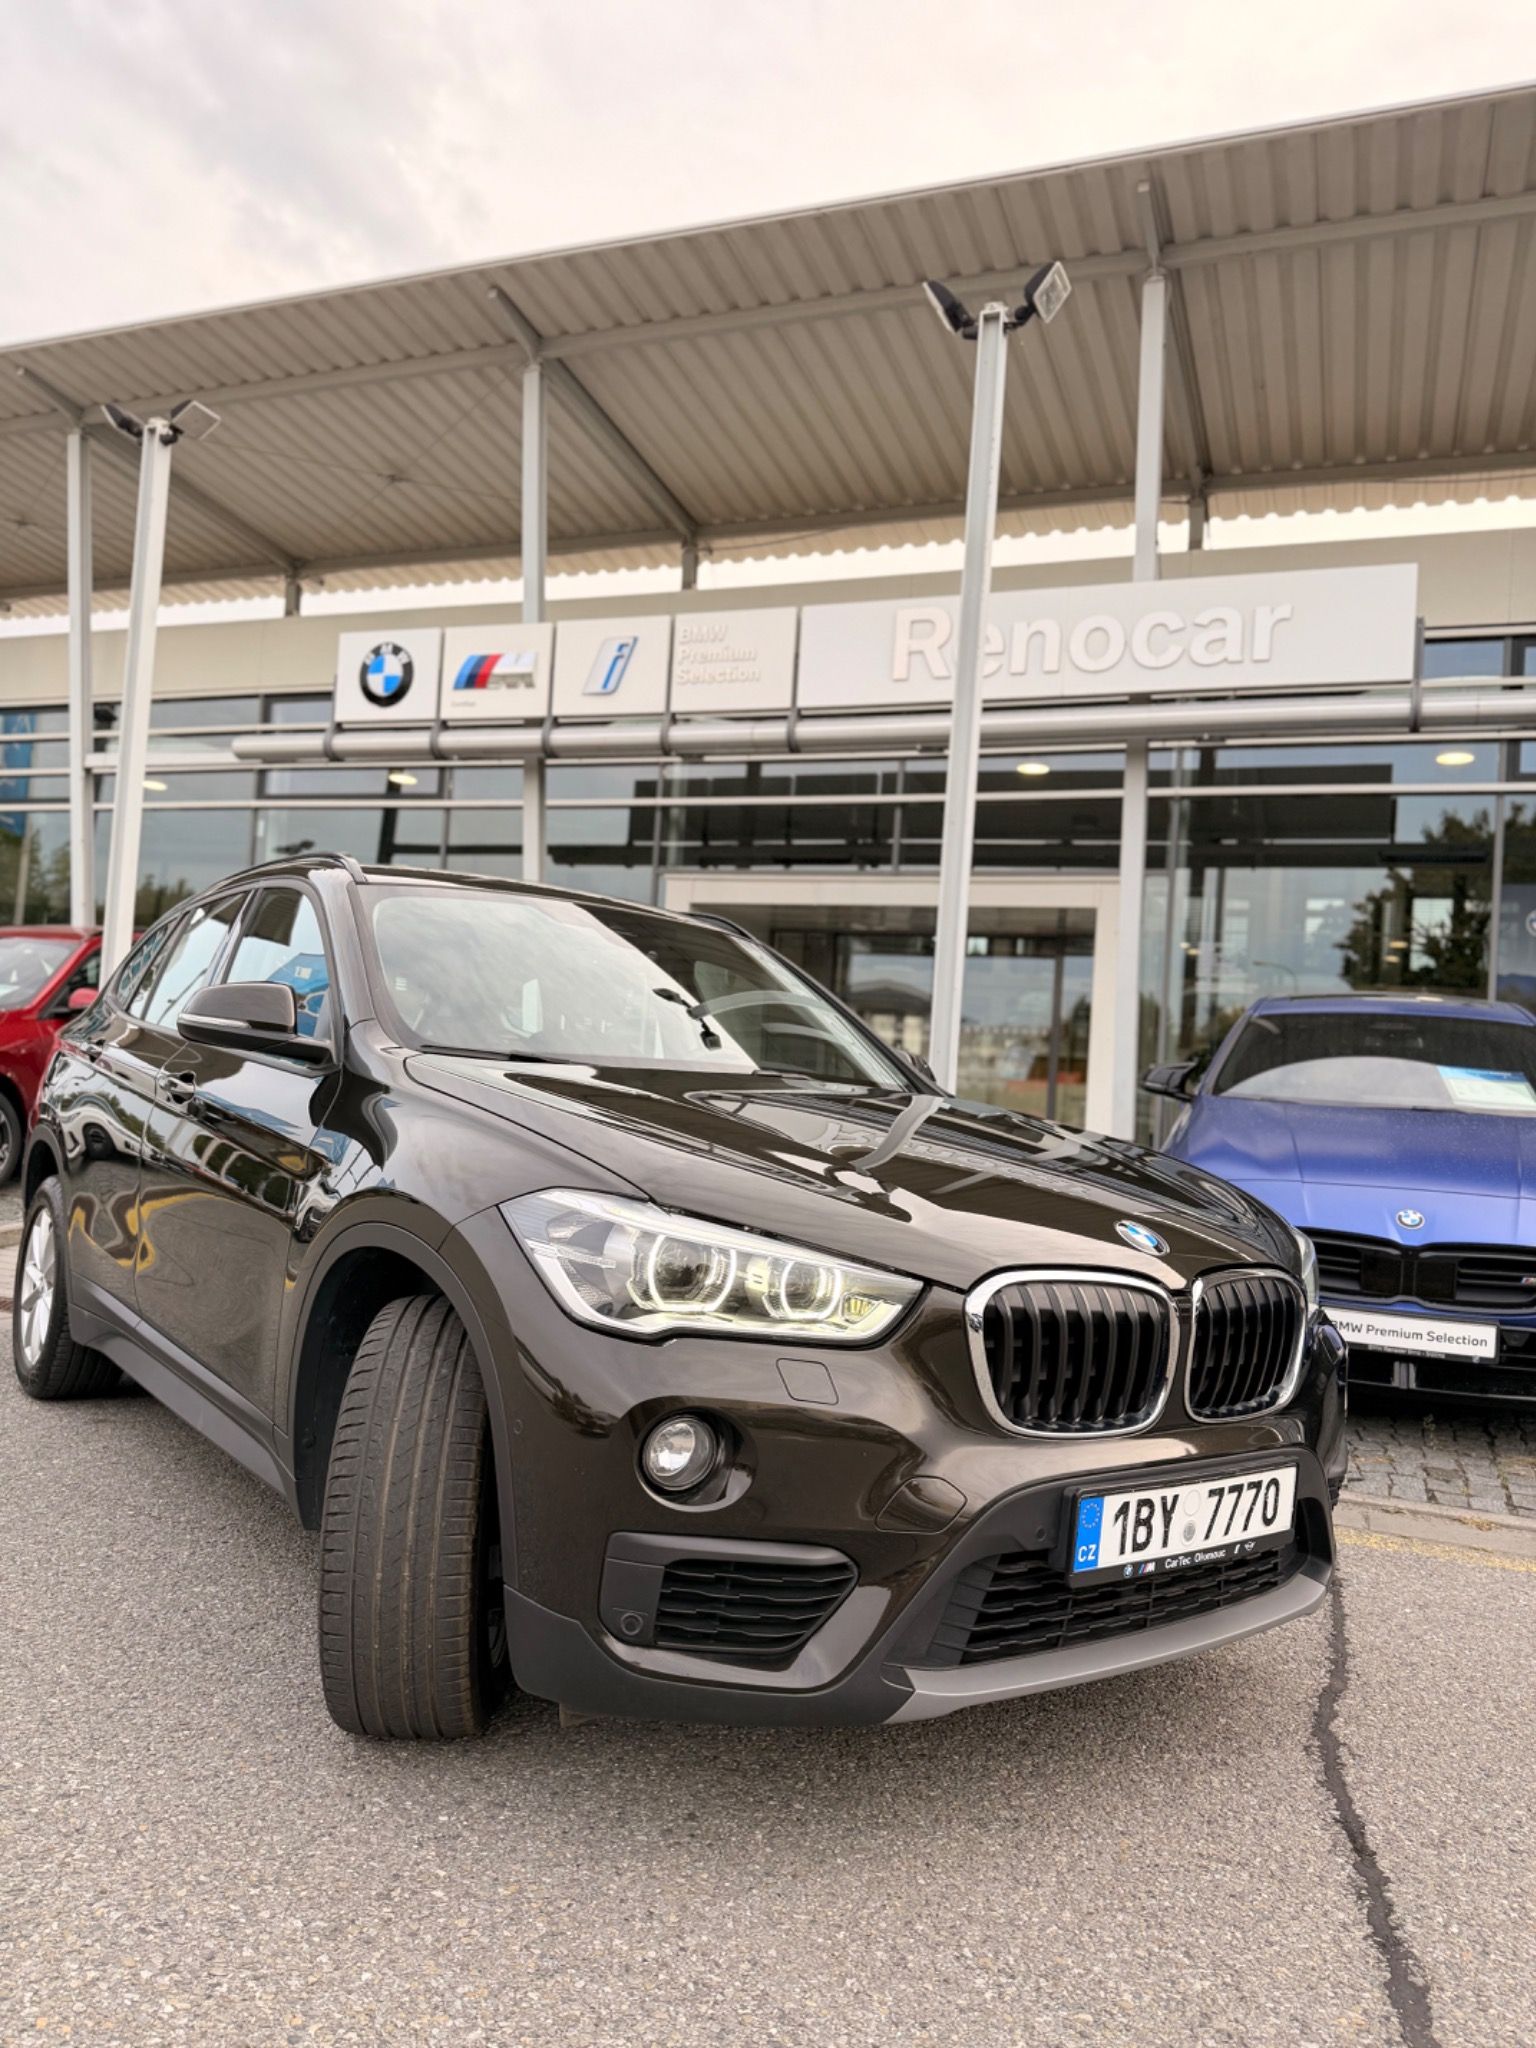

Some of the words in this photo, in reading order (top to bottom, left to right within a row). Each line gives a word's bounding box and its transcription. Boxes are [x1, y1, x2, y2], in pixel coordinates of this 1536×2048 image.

[679, 624, 728, 645] BMW
[678, 645, 758, 666] Premium
[677, 665, 762, 686] Selection
[1366, 1323, 1424, 1342] Premium
[1426, 1331, 1489, 1349] Selection
[1112, 1494, 1180, 1556] 1BY
[1203, 1477, 1281, 1542] 7770
[1077, 1543, 1097, 1563] CZ
[1165, 1554, 1192, 1570] CarTec
